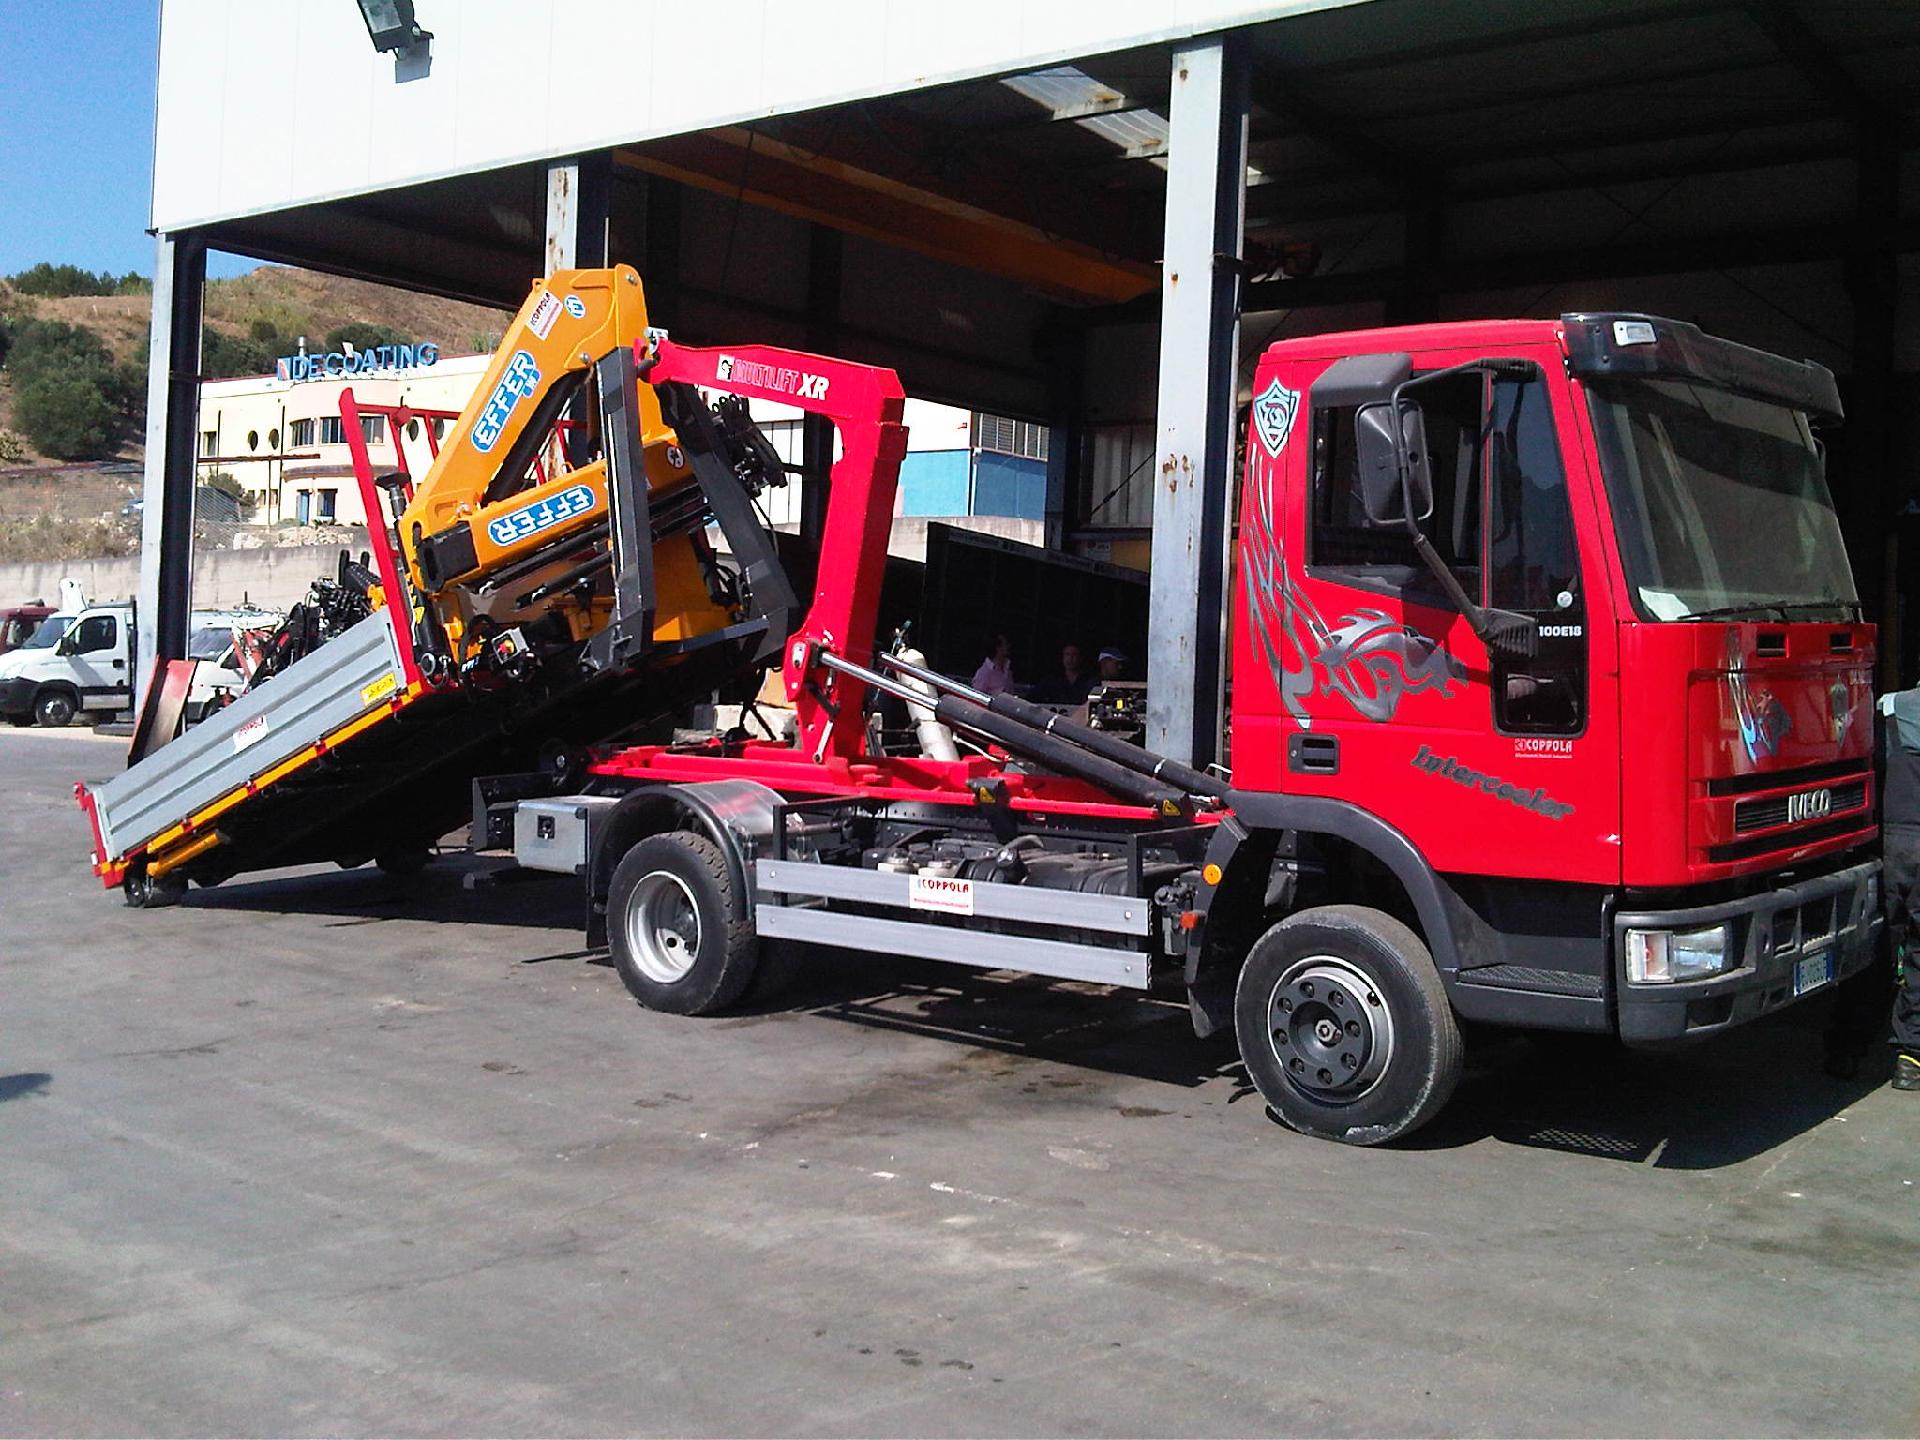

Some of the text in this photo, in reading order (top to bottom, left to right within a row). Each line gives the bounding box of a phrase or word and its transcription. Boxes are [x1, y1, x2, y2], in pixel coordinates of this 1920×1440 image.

[291, 341, 439, 381] DECOATING
[731, 359, 830, 400] MULTILIFT XR
[474, 353, 535, 446] EFFER
[492, 488, 590, 541] EFFER
[1538, 625, 1582, 637] 100E18
[1525, 739, 1572, 752] COPPOLA
[1788, 788, 1831, 823] IVECO
[922, 879, 969, 893] COPPOLA
